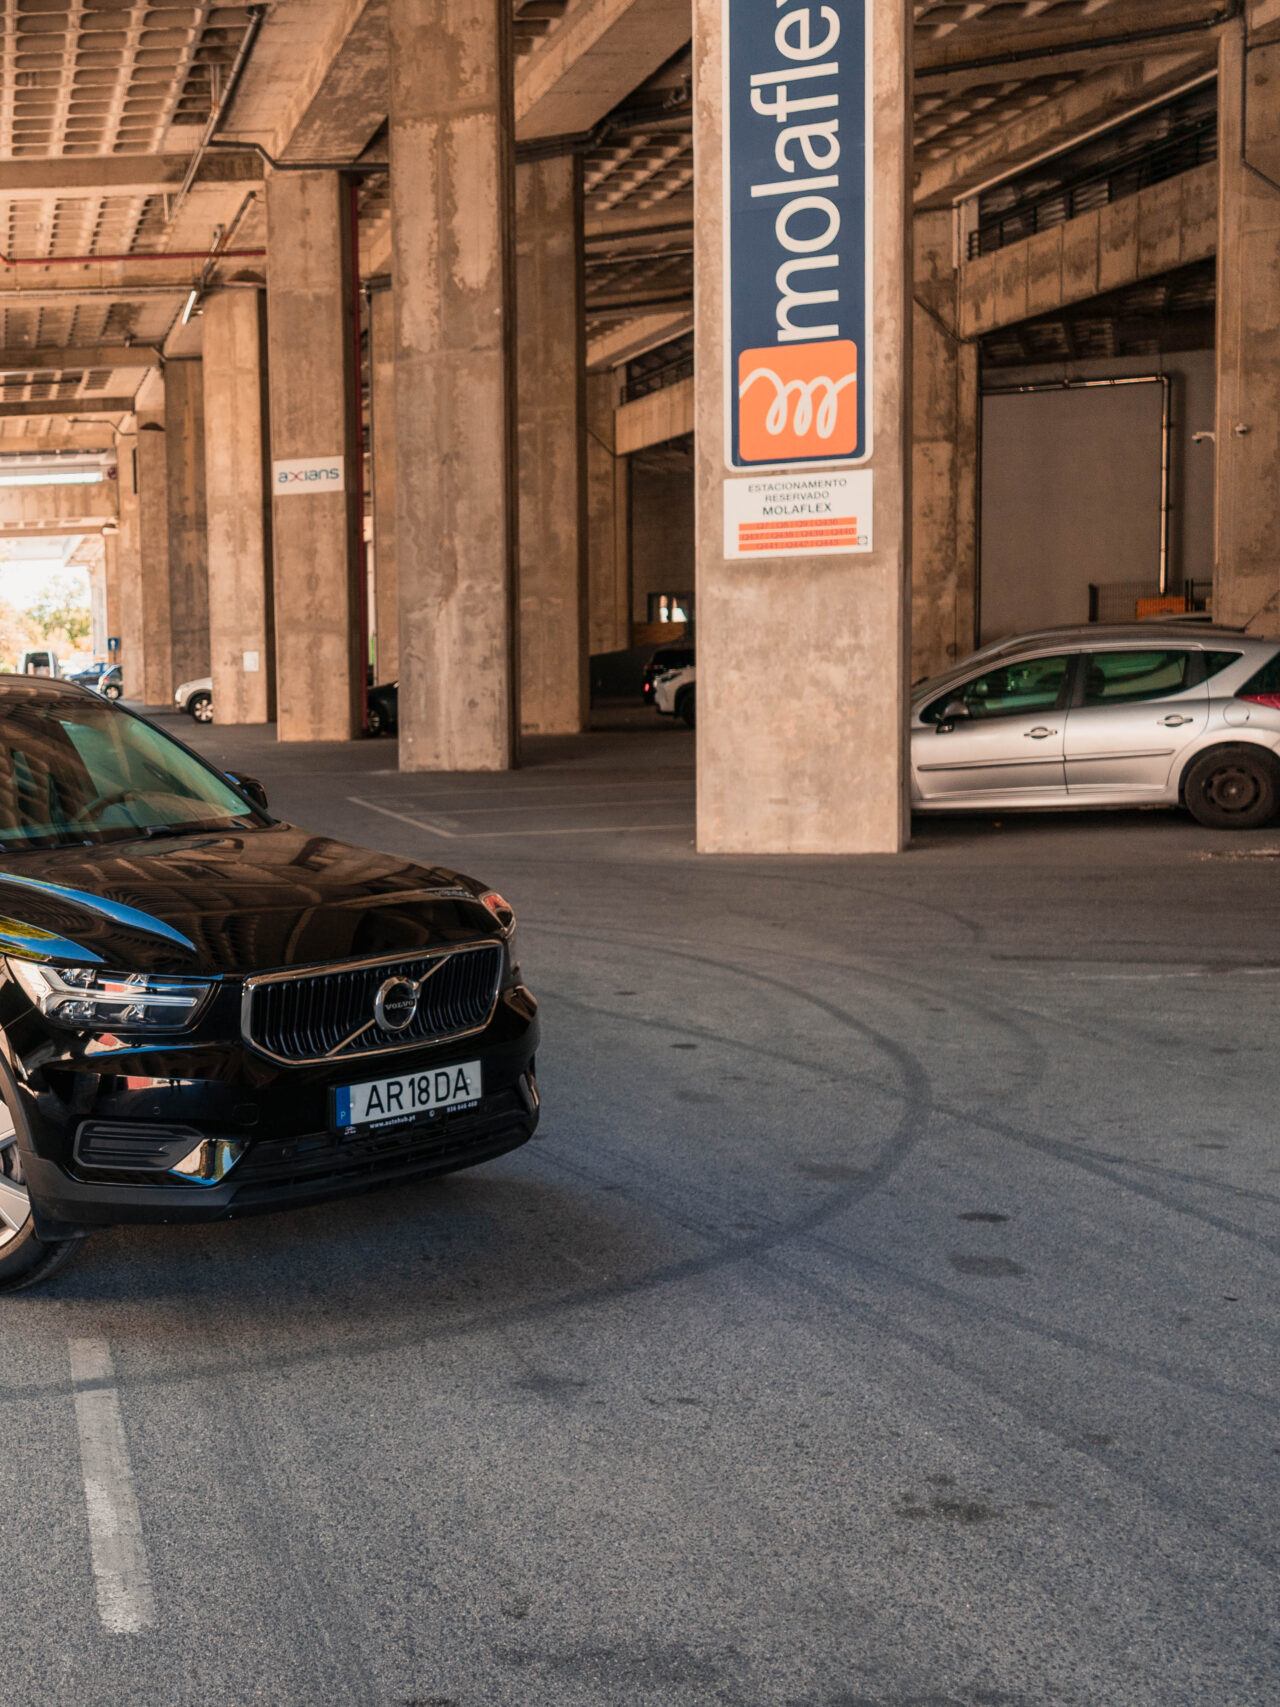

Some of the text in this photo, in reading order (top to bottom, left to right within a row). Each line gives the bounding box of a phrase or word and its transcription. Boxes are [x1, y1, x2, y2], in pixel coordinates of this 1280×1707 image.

[749, 0, 841, 341] molafle
[278, 468, 339, 483] axians
[748, 478, 847, 492] ESTACIONAMENTO
[765, 490, 830, 502] RESERVADO
[762, 502, 832, 515] MOLAFLEX
[385, 1000, 414, 1010] VOLVO
[340, 1111, 346, 1120] P
